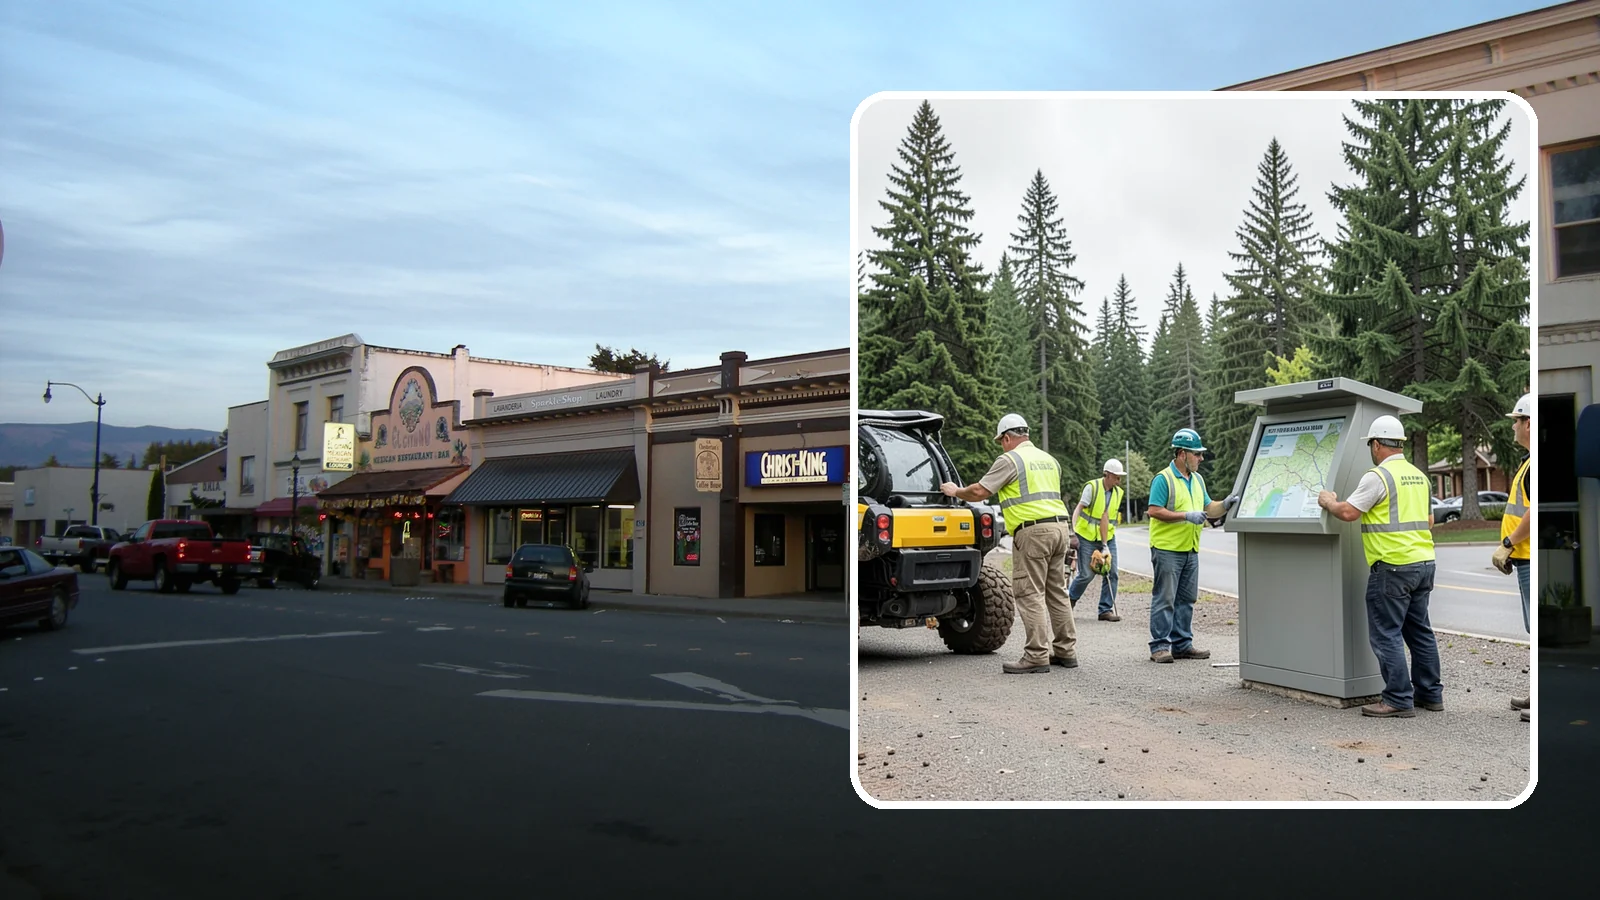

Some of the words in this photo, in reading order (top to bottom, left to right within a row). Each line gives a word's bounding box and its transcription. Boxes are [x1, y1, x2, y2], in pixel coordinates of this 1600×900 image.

[493, 401, 523, 413] LAVANDERIA
[530, 397, 561, 409] Sparkle
[561, 394, 583, 406] Shop
[595, 389, 623, 400] LAUNDRY
[373, 455, 396, 464] MEXICAN
[397, 452, 434, 462] RESTAURANT
[438, 450, 450, 459] BAR
[761, 452, 797, 478] CHRIST
[799, 450, 828, 477] KING
